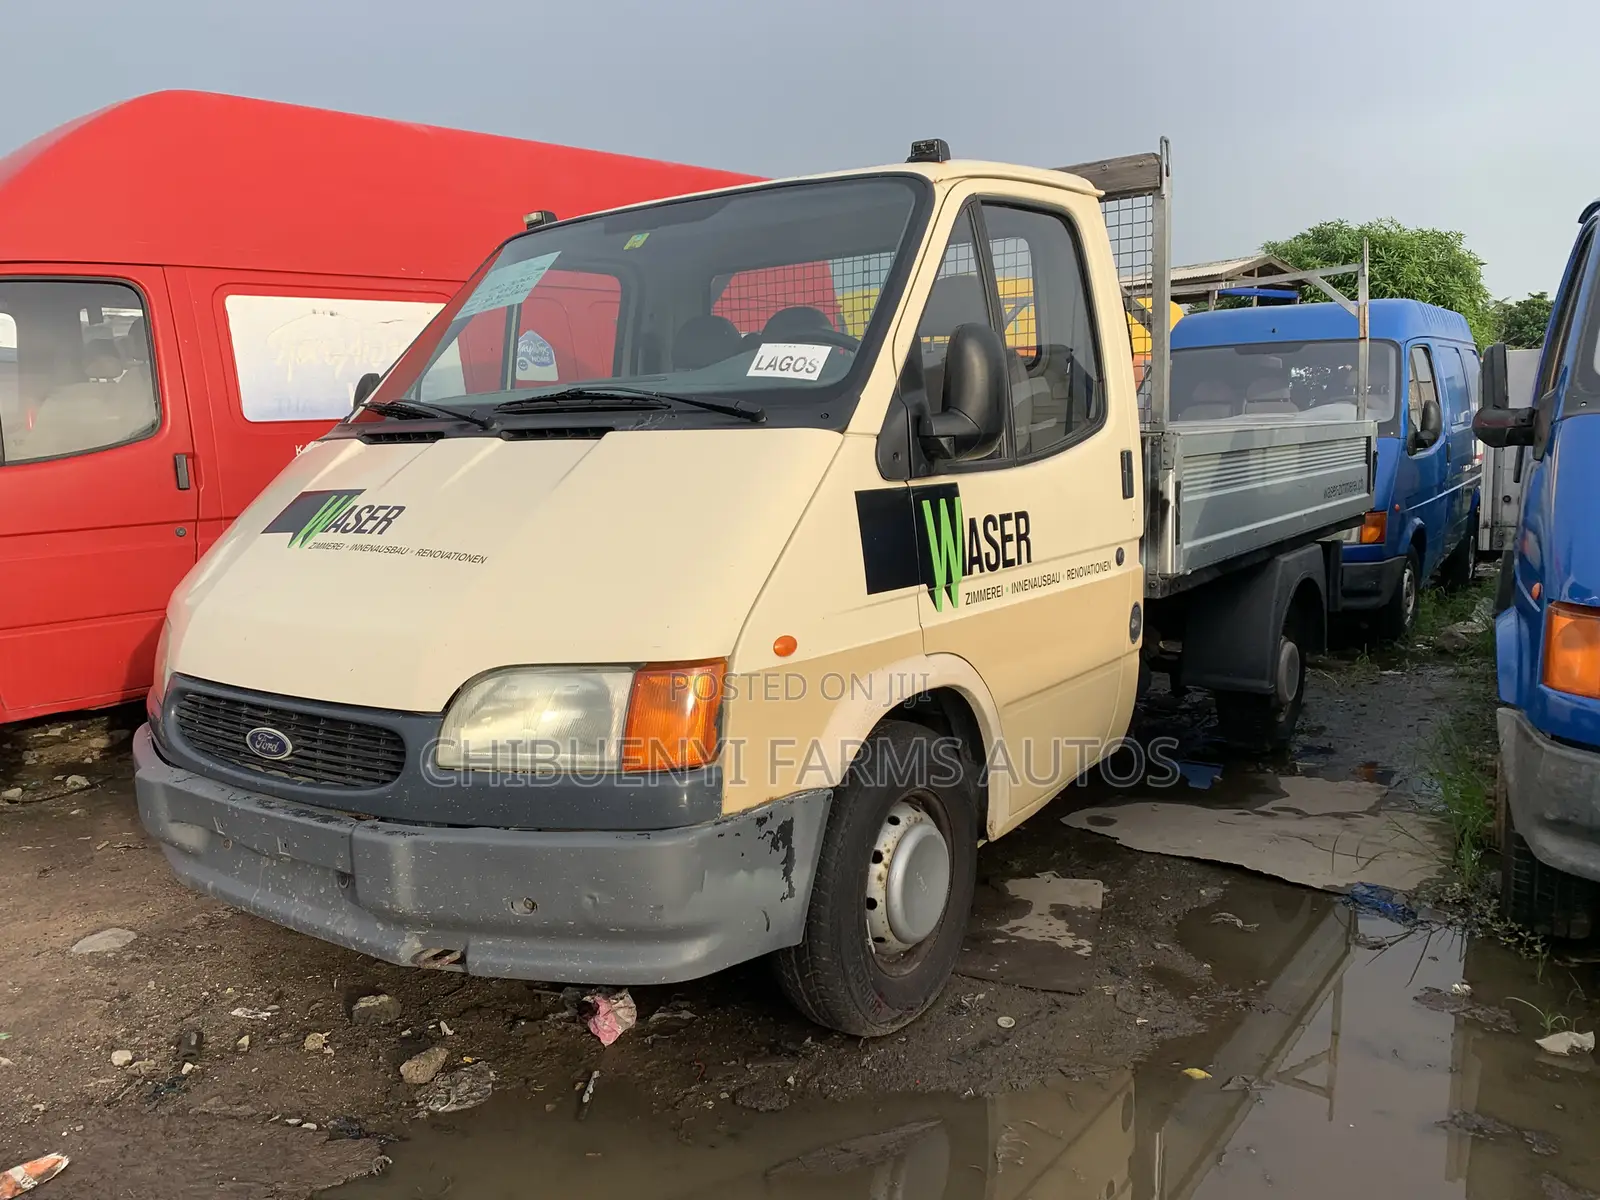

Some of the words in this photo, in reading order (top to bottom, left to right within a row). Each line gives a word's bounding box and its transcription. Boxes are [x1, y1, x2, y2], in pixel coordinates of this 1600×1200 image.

[753, 354, 820, 374] LAGOS
[287, 494, 406, 549] WASER
[307, 541, 346, 551] ZIMMEREI
[348, 543, 410, 556] INNENAUSBAU
[415, 548, 488, 565] RENOVATIONEN
[921, 496, 1033, 613] WASER
[964, 585, 1004, 606] ZIMMEREI
[1010, 571, 1061, 595] INNENAUSBAU
[1065, 560, 1112, 582] RENOVATIONEN
[255, 732, 281, 753] Ford
